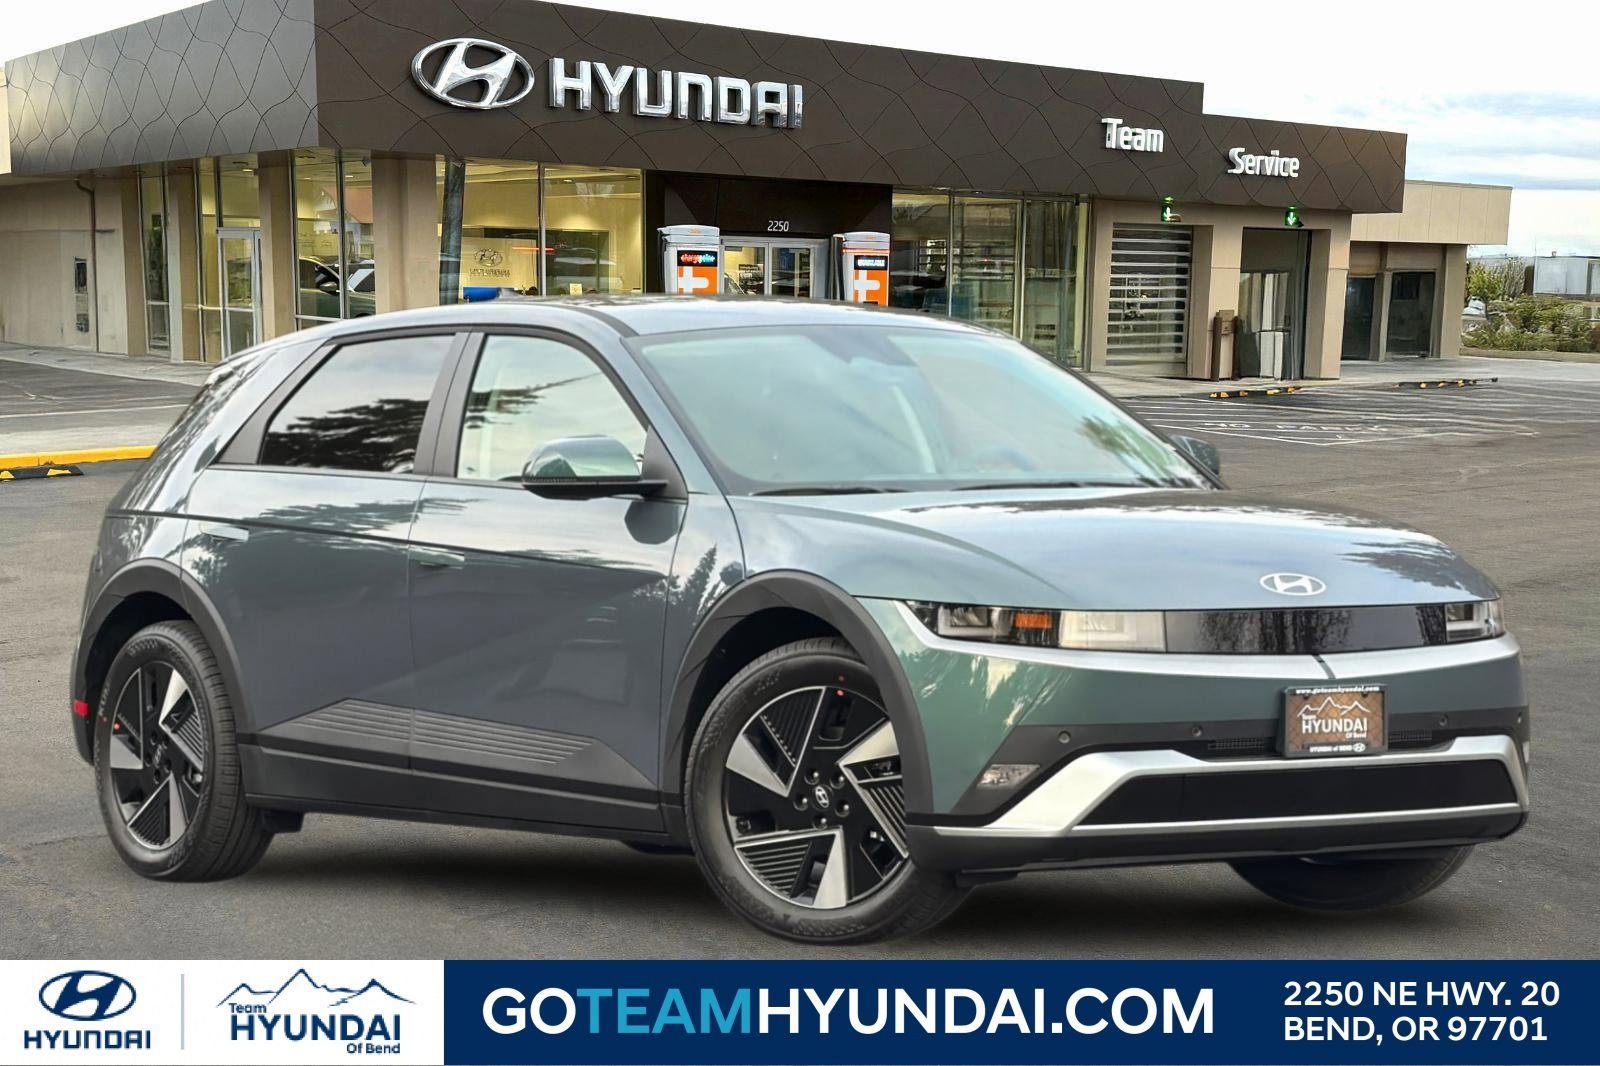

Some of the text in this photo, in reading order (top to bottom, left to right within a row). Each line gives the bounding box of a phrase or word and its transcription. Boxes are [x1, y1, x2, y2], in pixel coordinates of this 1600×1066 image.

[549, 57, 803, 129] HYUNDAI
[1101, 117, 1164, 153] Team
[1227, 147, 1300, 178] Service
[767, 220, 790, 232] 2250
[1302, 718, 1367, 734] HYUNDAI
